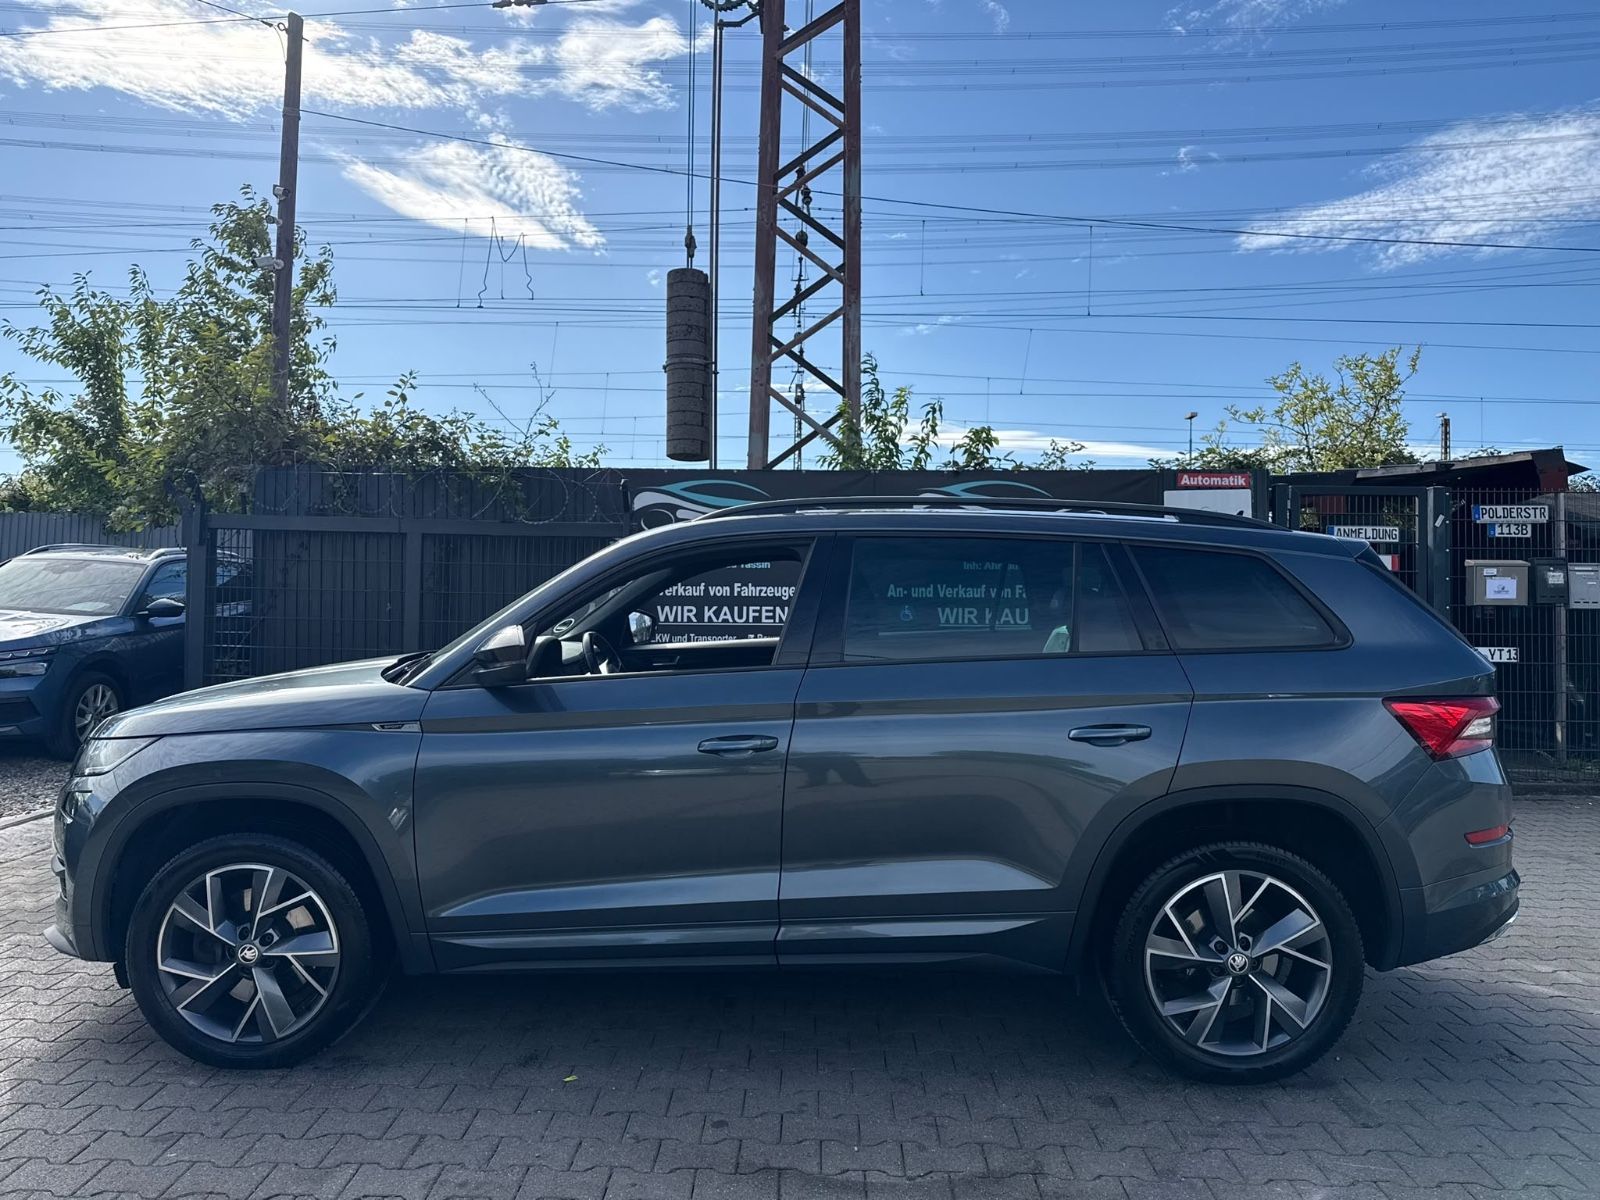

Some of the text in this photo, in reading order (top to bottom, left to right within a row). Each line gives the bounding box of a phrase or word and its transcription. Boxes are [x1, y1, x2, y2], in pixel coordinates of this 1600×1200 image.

[1181, 475, 1246, 486] Automatik
[1481, 507, 1547, 519] POLDERSTR
[1336, 528, 1397, 540] ANMELDUNG
[1497, 523, 1528, 535] 113B
[660, 583, 705, 597] erkauf
[709, 586, 730, 597] von
[887, 584, 908, 598] An-
[911, 584, 934, 598] und
[938, 584, 987, 598] Verkauf
[657, 606, 788, 623] WIR KAUFEN
[938, 607, 979, 624] WIR
[672, 634, 687, 642] und
